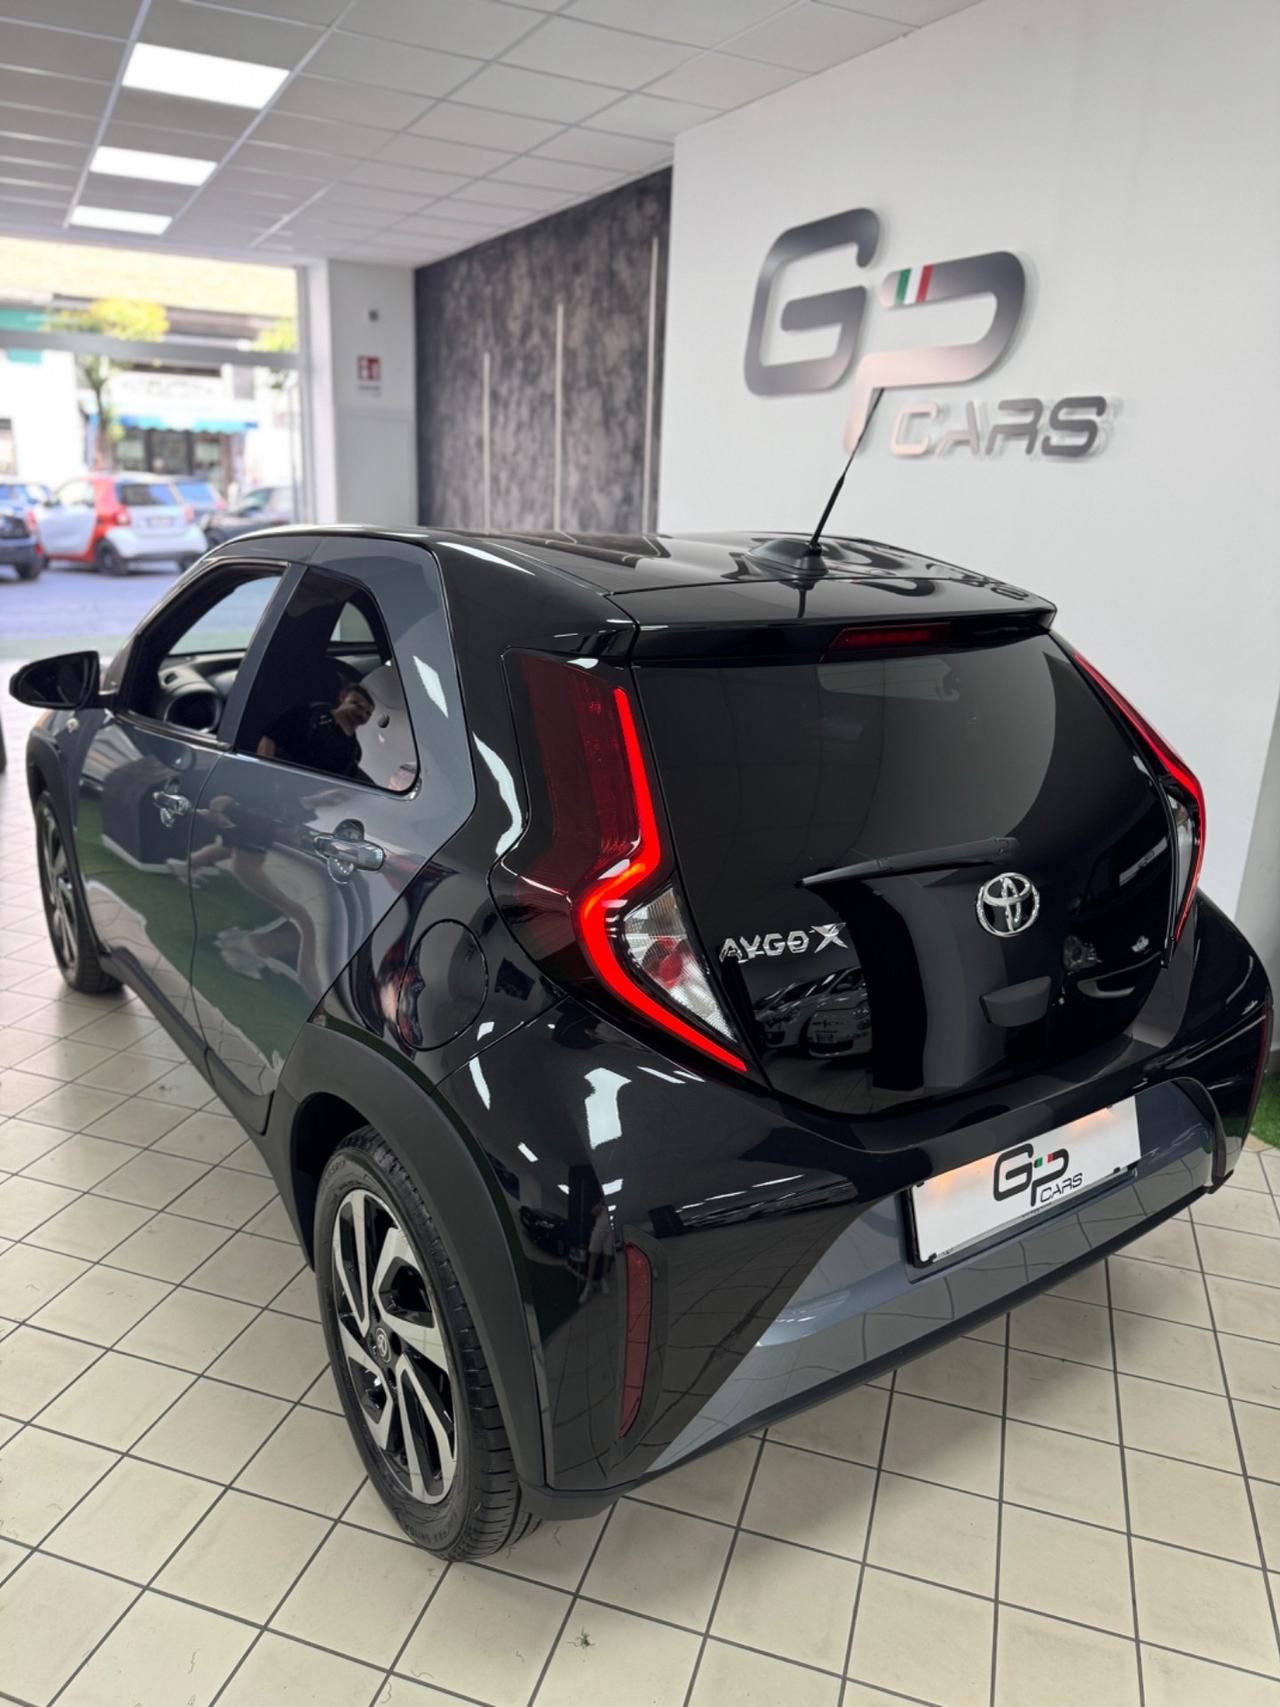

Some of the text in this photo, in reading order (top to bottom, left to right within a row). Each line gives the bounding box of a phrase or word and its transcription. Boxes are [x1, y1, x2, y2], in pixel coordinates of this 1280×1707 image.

[744, 207, 1026, 456] GP
[890, 395, 1106, 458] CARS
[718, 922, 848, 963] AYGO X
[993, 1143, 1069, 1207] GP
[1040, 1172, 1083, 1203] CARS
